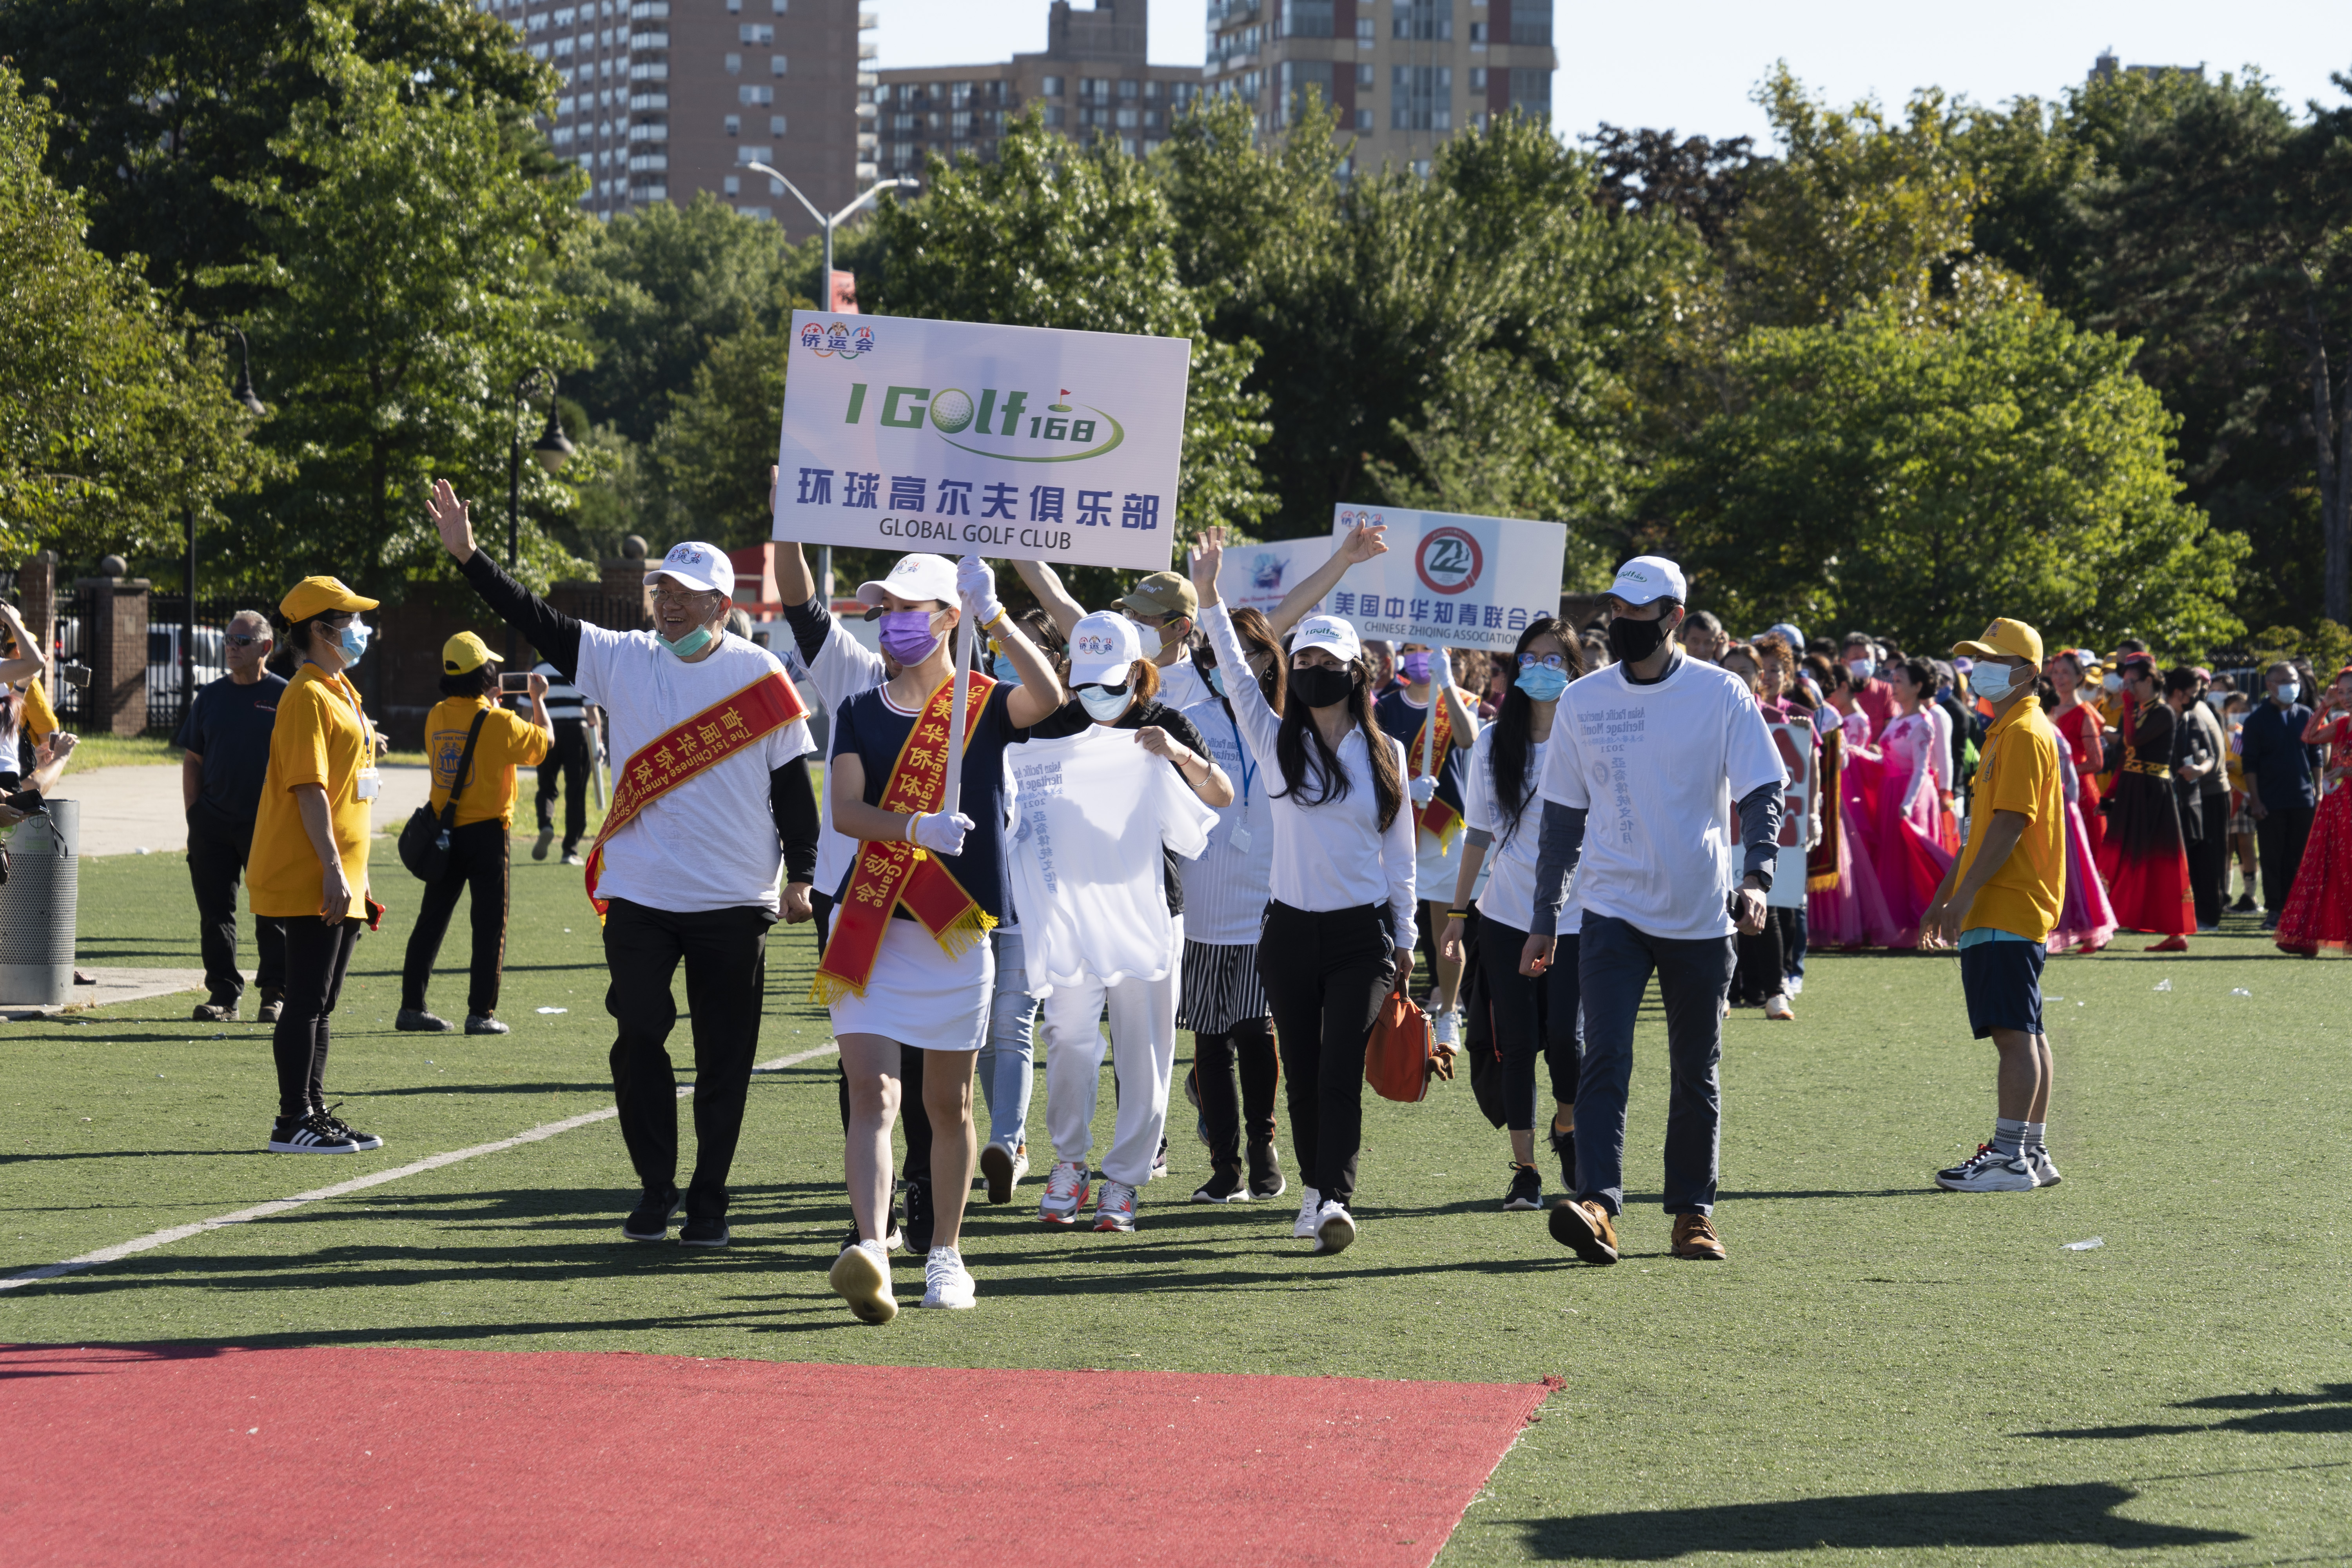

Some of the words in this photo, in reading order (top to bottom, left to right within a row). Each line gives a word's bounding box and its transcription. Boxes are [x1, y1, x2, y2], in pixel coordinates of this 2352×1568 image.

[802, 334, 874, 351] 侨运会
[1030, 416, 1096, 443] 168
[796, 467, 1160, 530] 环球高尔夫俱乐部
[879, 517, 957, 541] GLOBAL
[962, 524, 1014, 545] GOLF
[1020, 528, 1072, 550] CLUB
[1364, 621, 1406, 635] CHINESE
[1408, 625, 1451, 639] ZHIQING
[1452, 629, 1520, 644] ASSOCIATION
[1079, 642, 1113, 651] 侨运会
[711, 739, 730, 754] 1st
[730, 726, 753, 743] The
[670, 750, 713, 778] Chinese
[630, 775, 670, 808] American
[873, 864, 902, 908] Game
